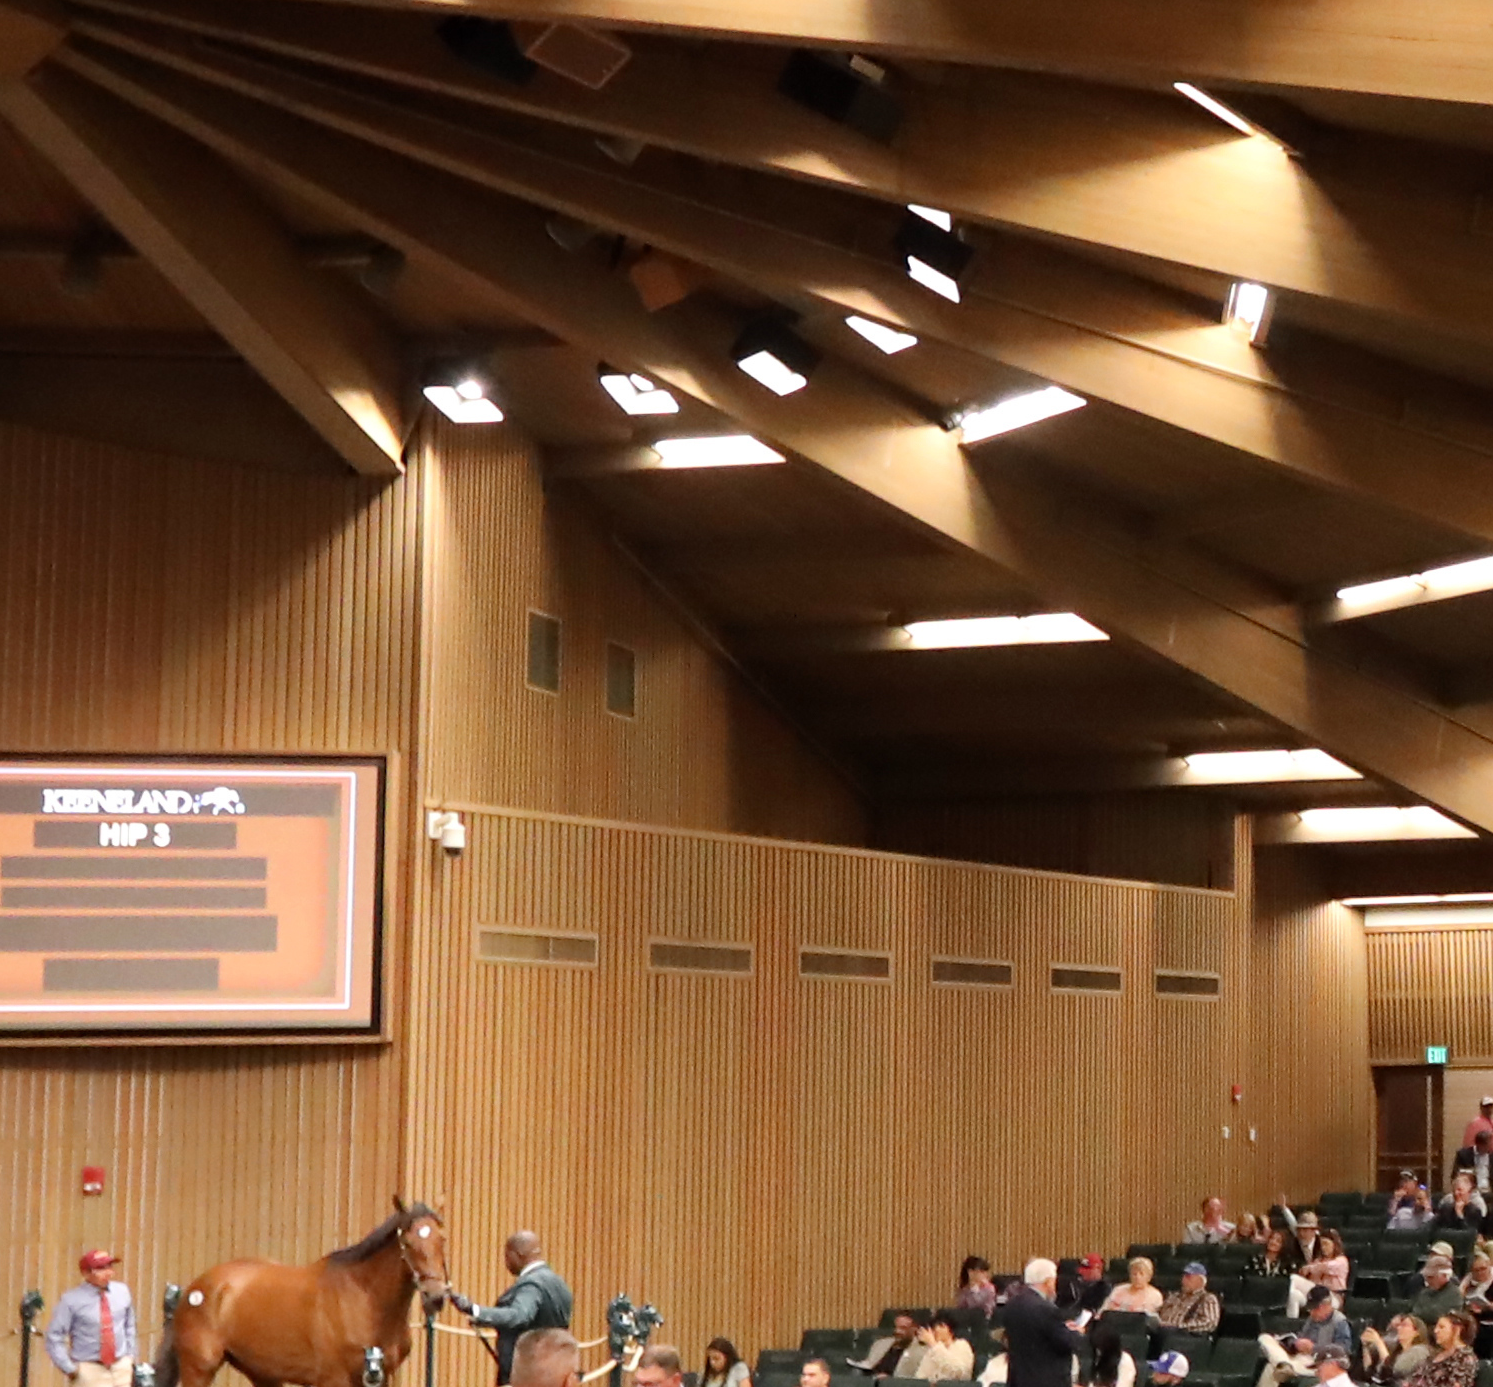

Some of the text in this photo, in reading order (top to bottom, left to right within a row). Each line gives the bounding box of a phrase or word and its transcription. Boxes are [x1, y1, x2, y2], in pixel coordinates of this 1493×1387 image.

[42, 789, 193, 814] KEENELAND
[99, 822, 171, 847] HIP 3
